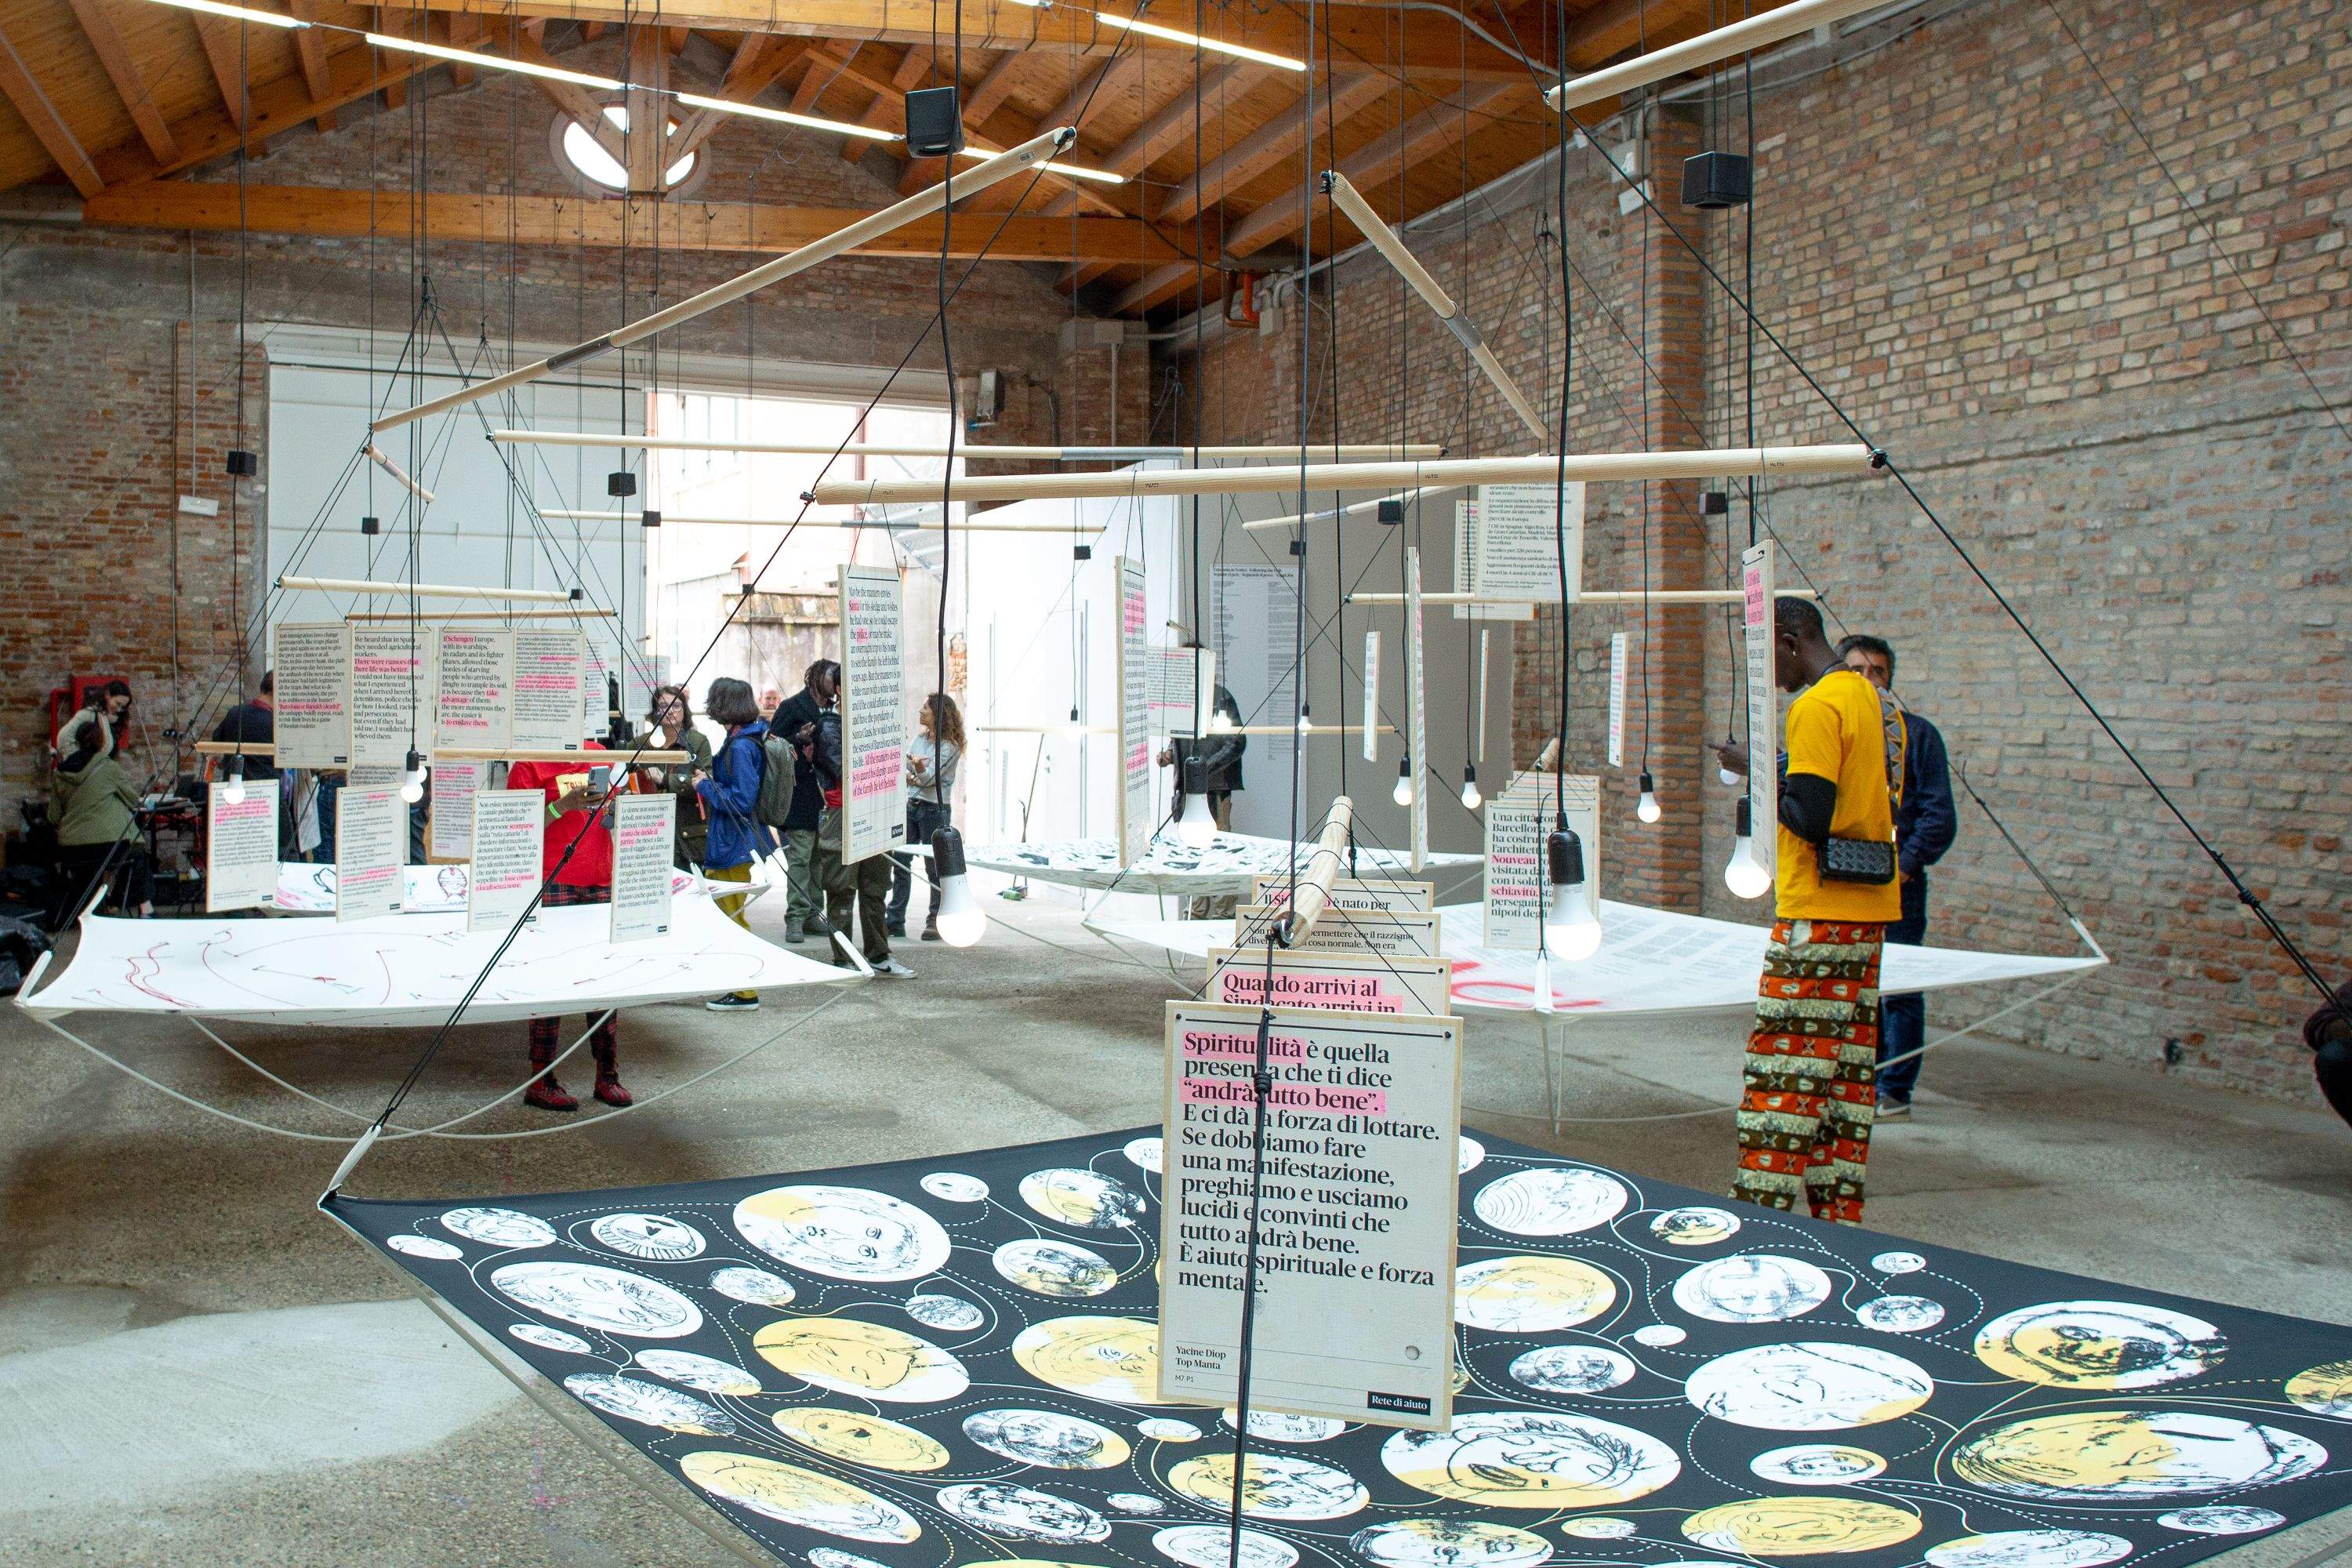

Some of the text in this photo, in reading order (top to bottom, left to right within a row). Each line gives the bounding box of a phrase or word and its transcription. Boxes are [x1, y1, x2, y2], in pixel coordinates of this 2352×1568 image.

[848, 601, 859, 612] Santa
[1493, 812, 1512, 822] Una
[1514, 812, 1535, 822] città
[1493, 833, 1504, 842] ha
[1492, 855, 1535, 864] Nouveau
[1492, 866, 1526, 875] visitata
[1518, 877, 1542, 886] sold
[1342, 899, 1367, 909] nato
[1370, 901, 1391, 911] per
[1491, 907, 1547, 919] nipoti degi
[1249, 927, 1265, 935] Non
[1370, 930, 1375, 938] il
[1377, 931, 1414, 940] razzismo
[1224, 973, 1377, 997] Quando arrivi al
[1224, 994, 1317, 1011] Sindcato
[1185, 1033, 1390, 1065] Spiritulità è quella
[1184, 1059, 1392, 1087] presena che ti dice
[1184, 1079, 1254, 1102] “andrà
[1316, 1088, 1378, 1112] bene”.
[1183, 1102, 1197, 1120] E
[1201, 1103, 1218, 1123] ci
[1224, 1105, 1249, 1125] dà
[1277, 1109, 1331, 1131] forza
[1337, 1114, 1357, 1134] di
[1363, 1116, 1439, 1140] lottare.
[1182, 1126, 1206, 1145] Se
[1323, 1137, 1366, 1159] fare
[1182, 1153, 1395, 1187] una manifestazione,
[1301, 1188, 1313, 1203] e
[1318, 1188, 1408, 1210] usciamo
[1181, 1196, 1390, 1233] lucidi e convinti che
[1180, 1222, 1230, 1242] tutto
[1302, 1231, 1359, 1254] bene.
[1179, 1240, 1434, 1285] È aiuto spirituale e forza
[1178, 1268, 1268, 1294] mentae.
[1176, 1346, 1226, 1359] Yacine Diop
[1175, 1357, 1221, 1370] Top Manta
[1372, 1395, 1428, 1410] Rete di aiuto
